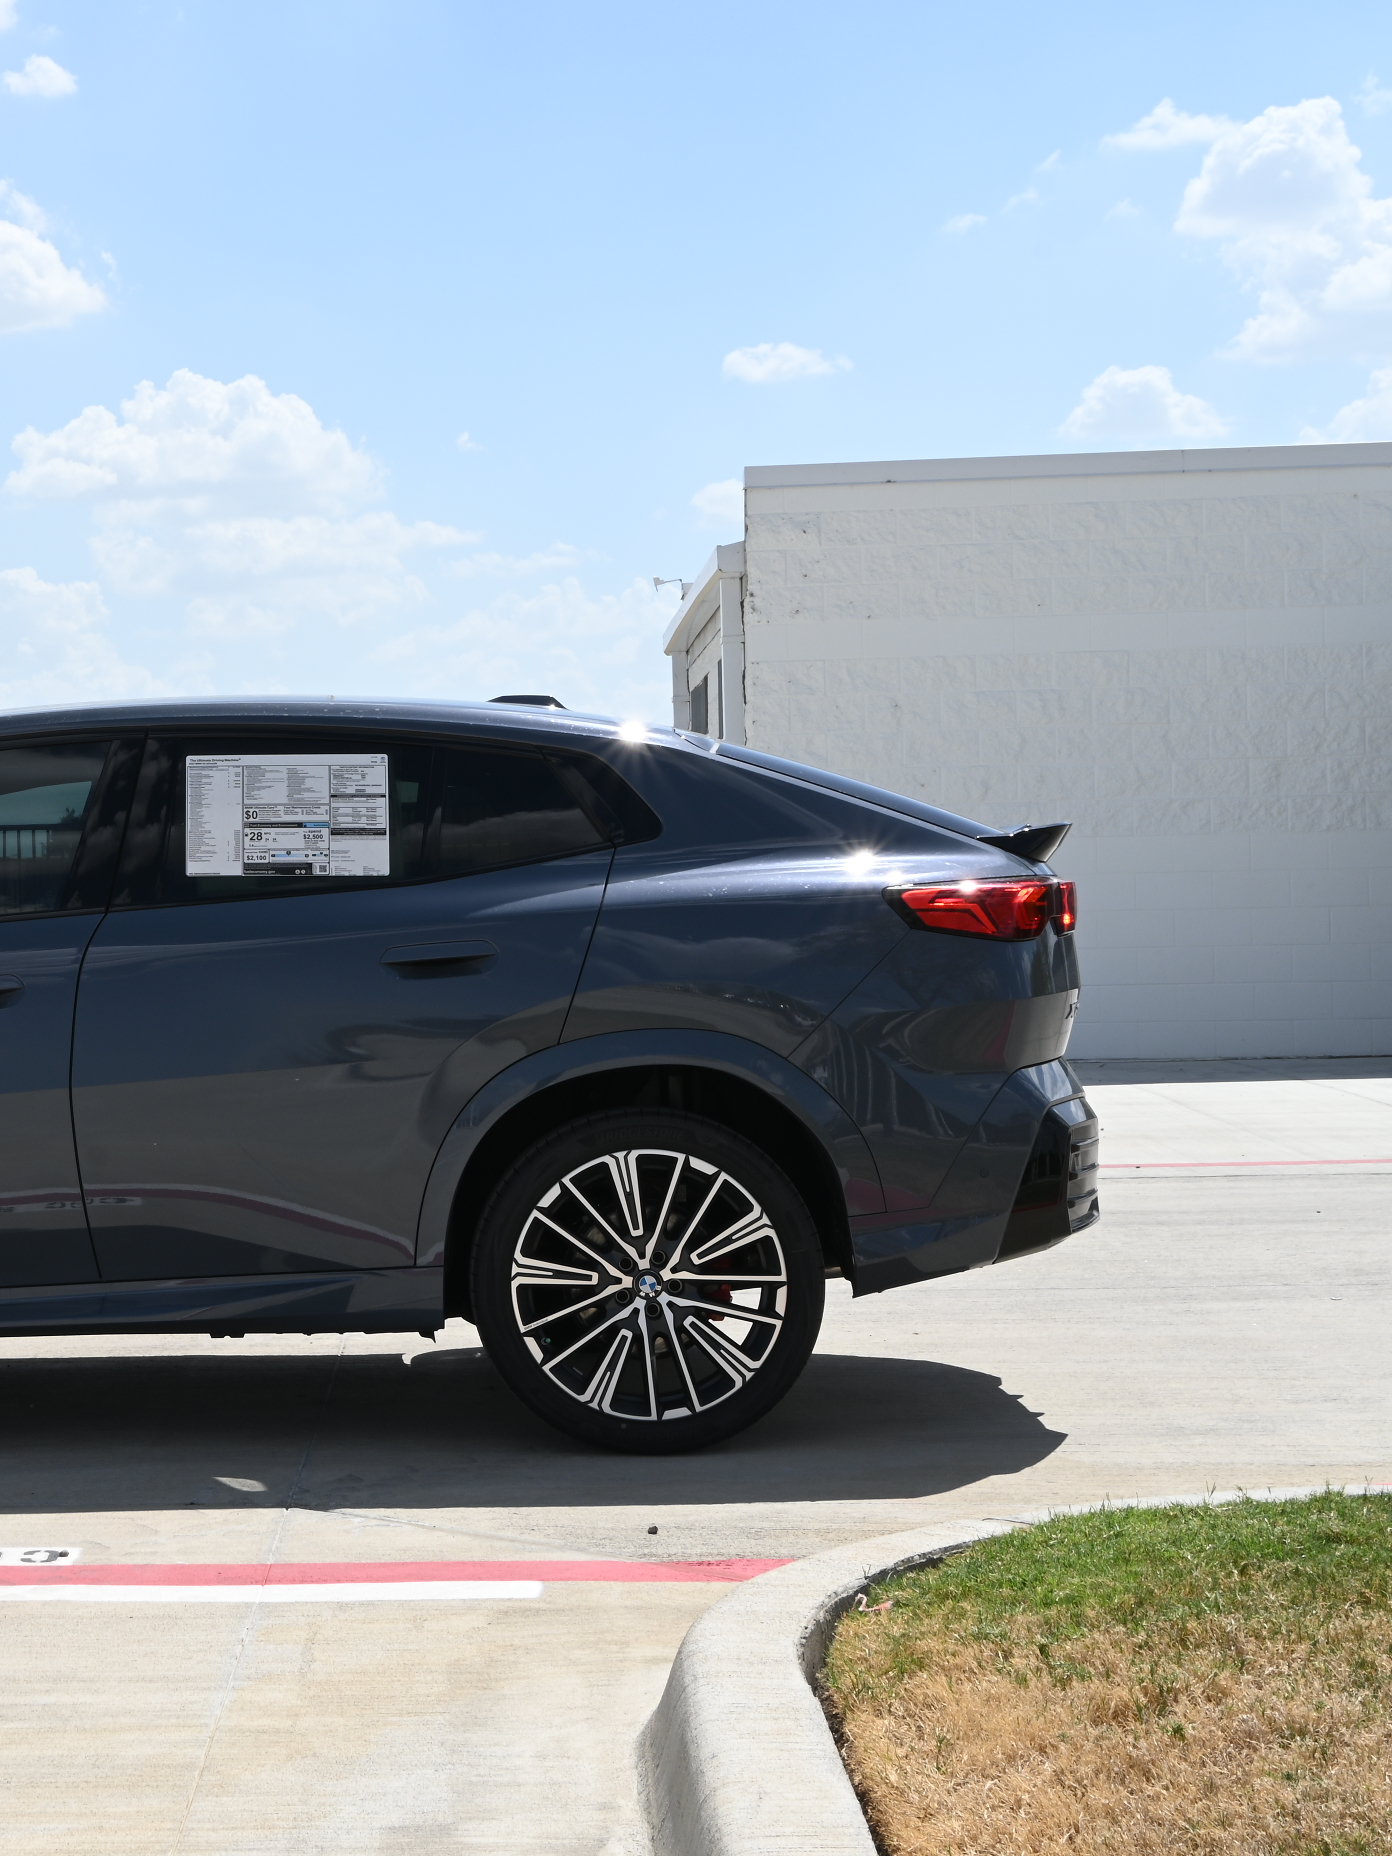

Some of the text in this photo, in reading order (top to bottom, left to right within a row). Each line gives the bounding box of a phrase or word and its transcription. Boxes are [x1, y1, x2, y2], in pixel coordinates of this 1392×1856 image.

[245, 810, 258, 820] $0
[249, 831, 263, 841] 28
[303, 833, 324, 841] $2,500
